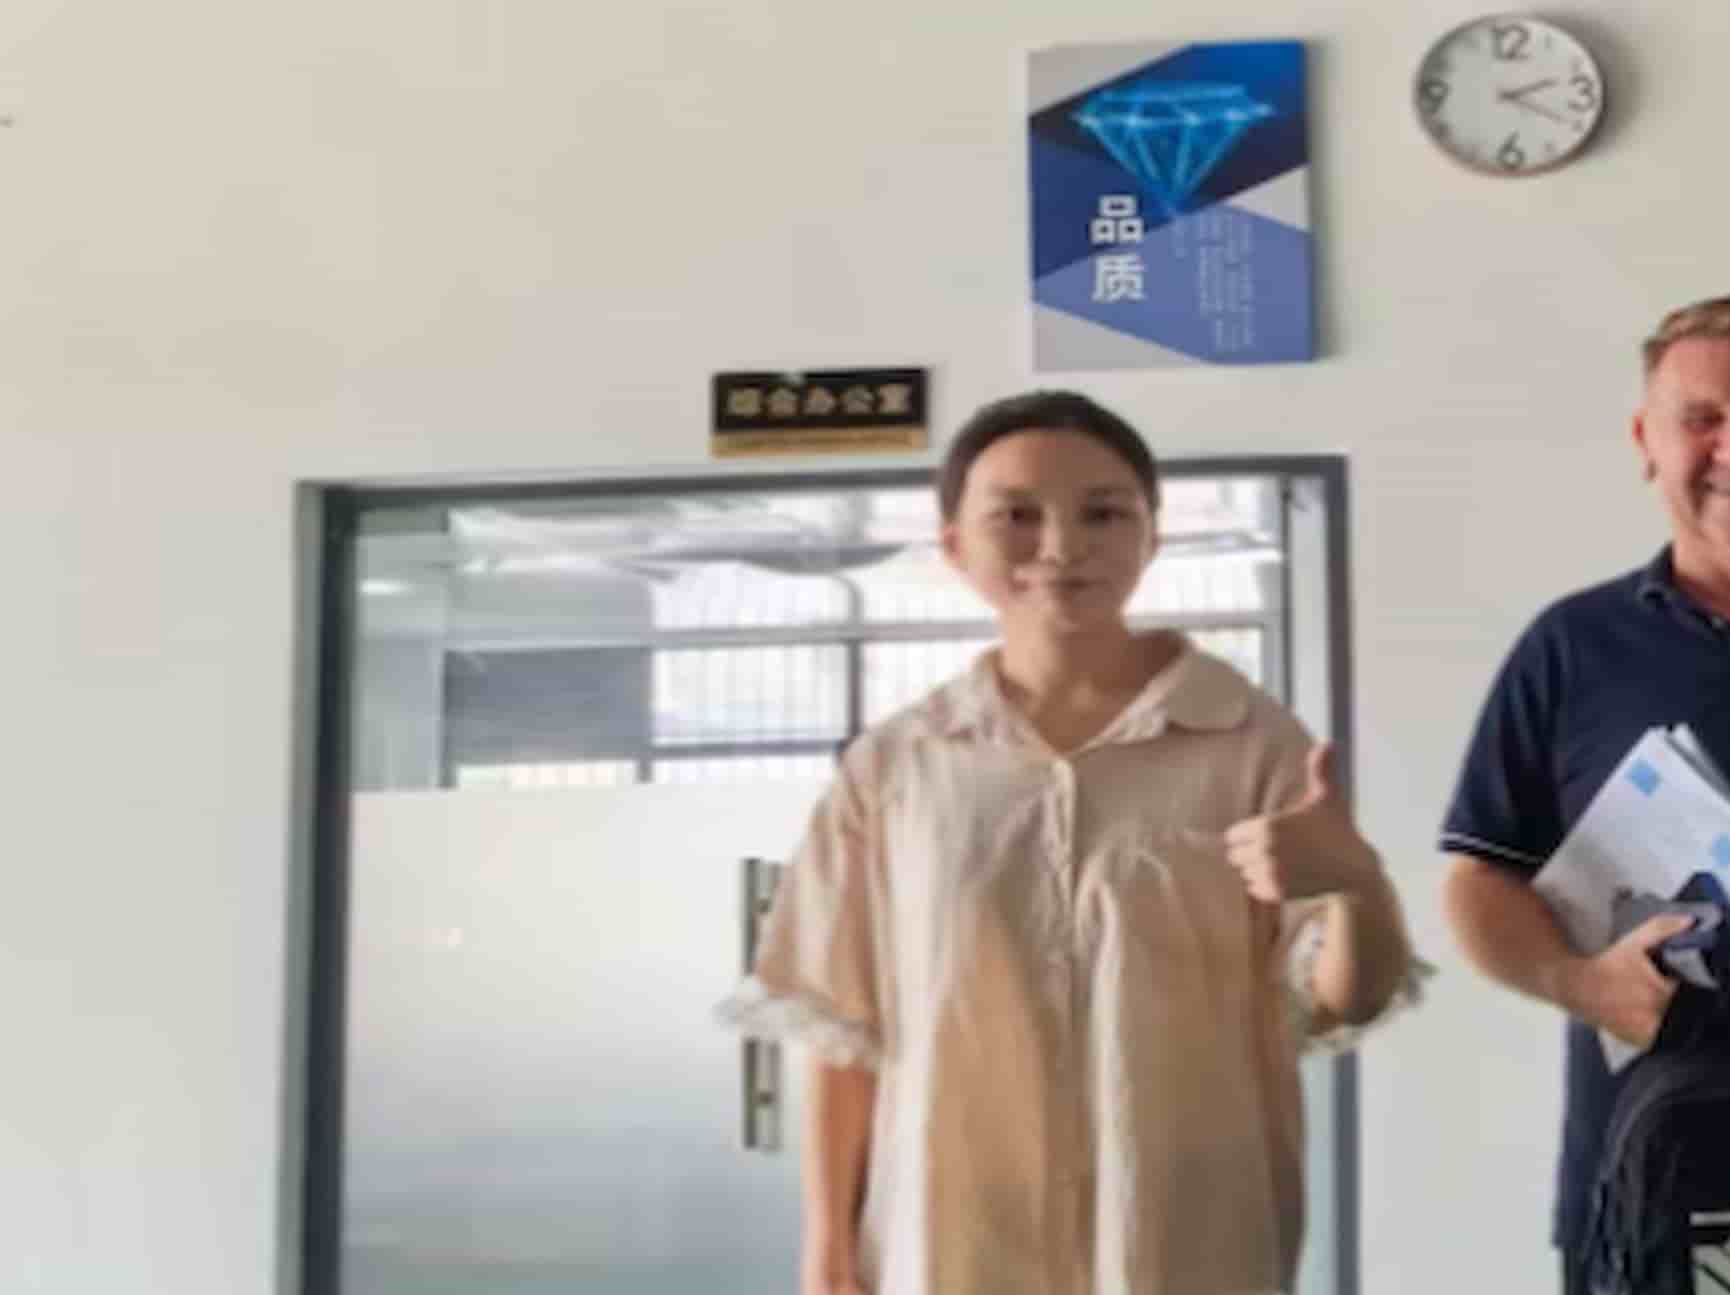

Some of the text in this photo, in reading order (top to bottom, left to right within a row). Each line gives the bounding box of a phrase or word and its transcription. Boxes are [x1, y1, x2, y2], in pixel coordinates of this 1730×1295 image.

[1492, 25, 1532, 60] 12
[1569, 75, 1594, 112] 3
[1498, 130, 1525, 170] 6
[1091, 194, 1145, 301] 品质
